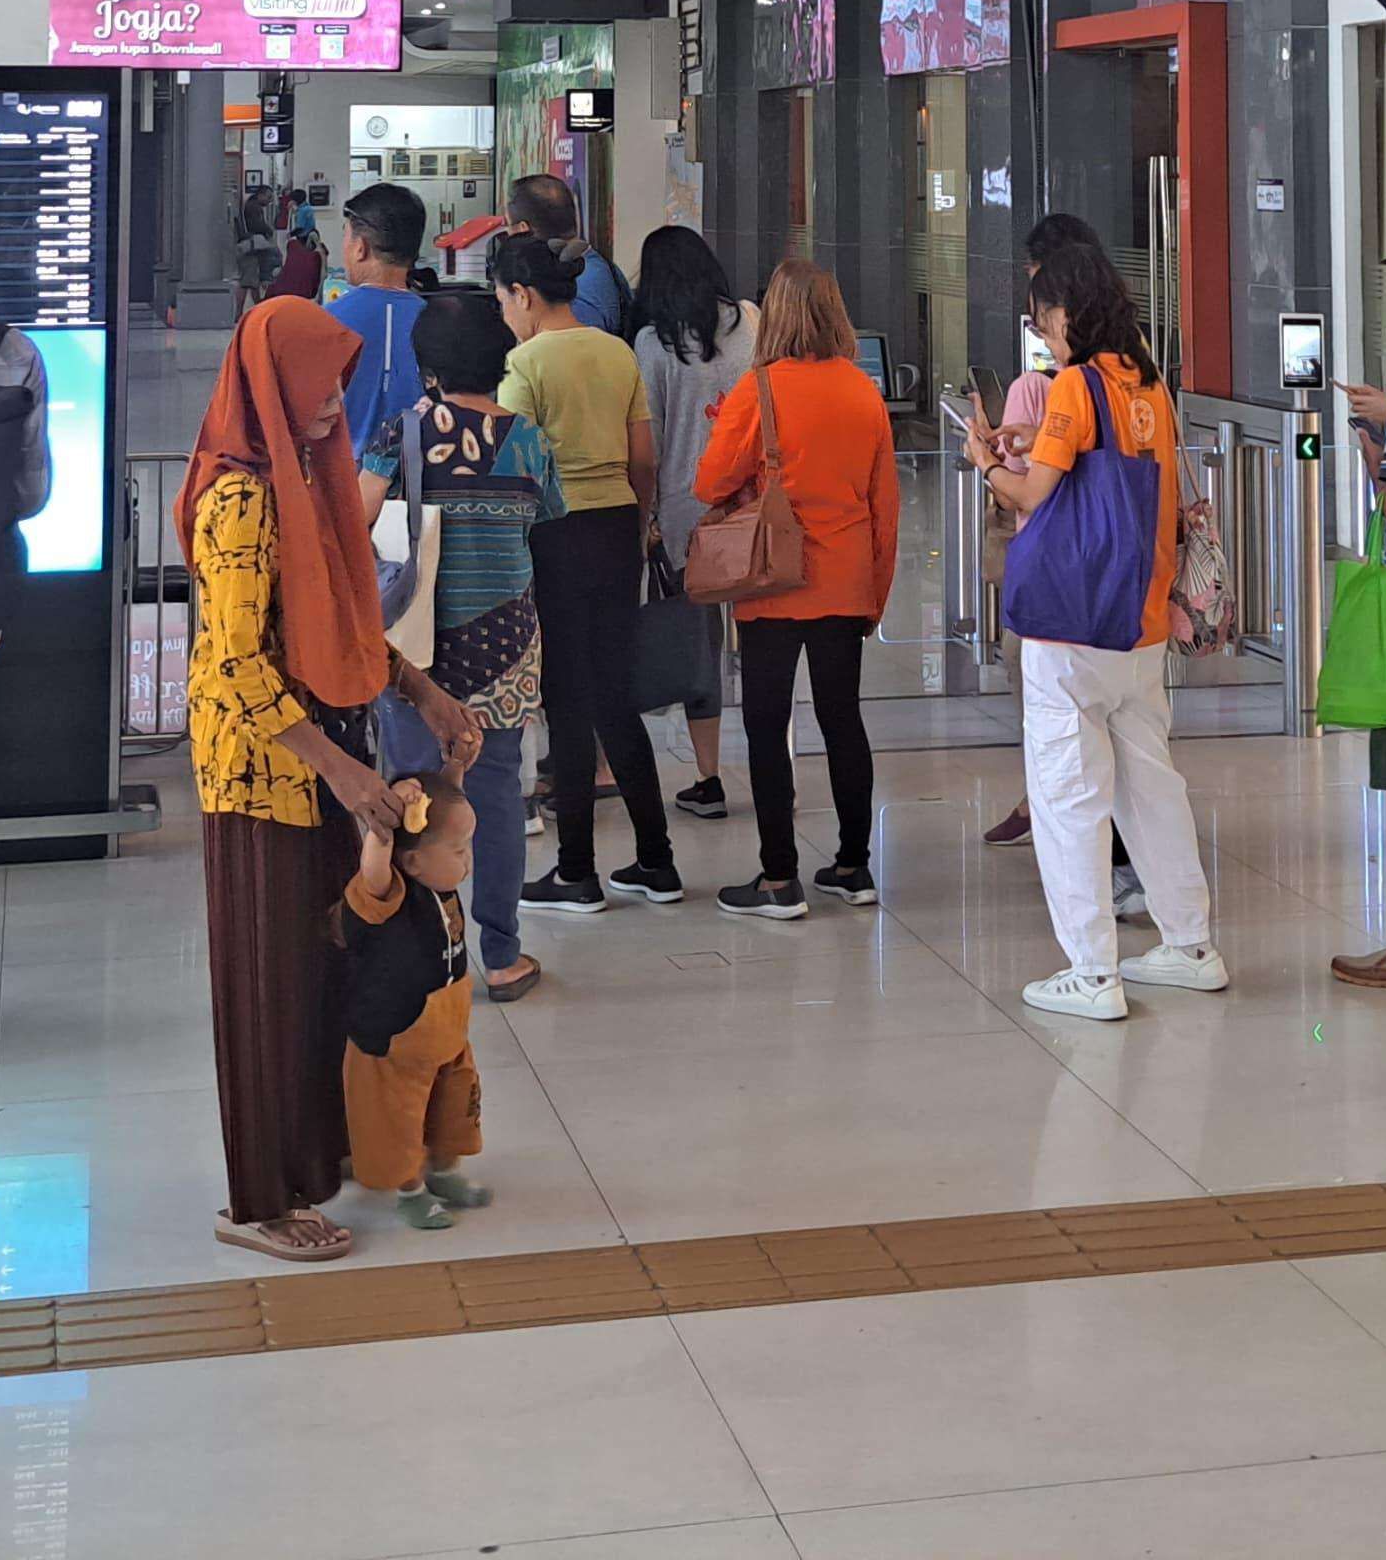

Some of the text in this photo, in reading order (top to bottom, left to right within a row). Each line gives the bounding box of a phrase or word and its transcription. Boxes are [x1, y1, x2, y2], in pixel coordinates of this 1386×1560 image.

[93, 0, 201, 41] Jogja?
[69, 42, 117, 57] Jangan
[120, 42, 150, 57] lupa
